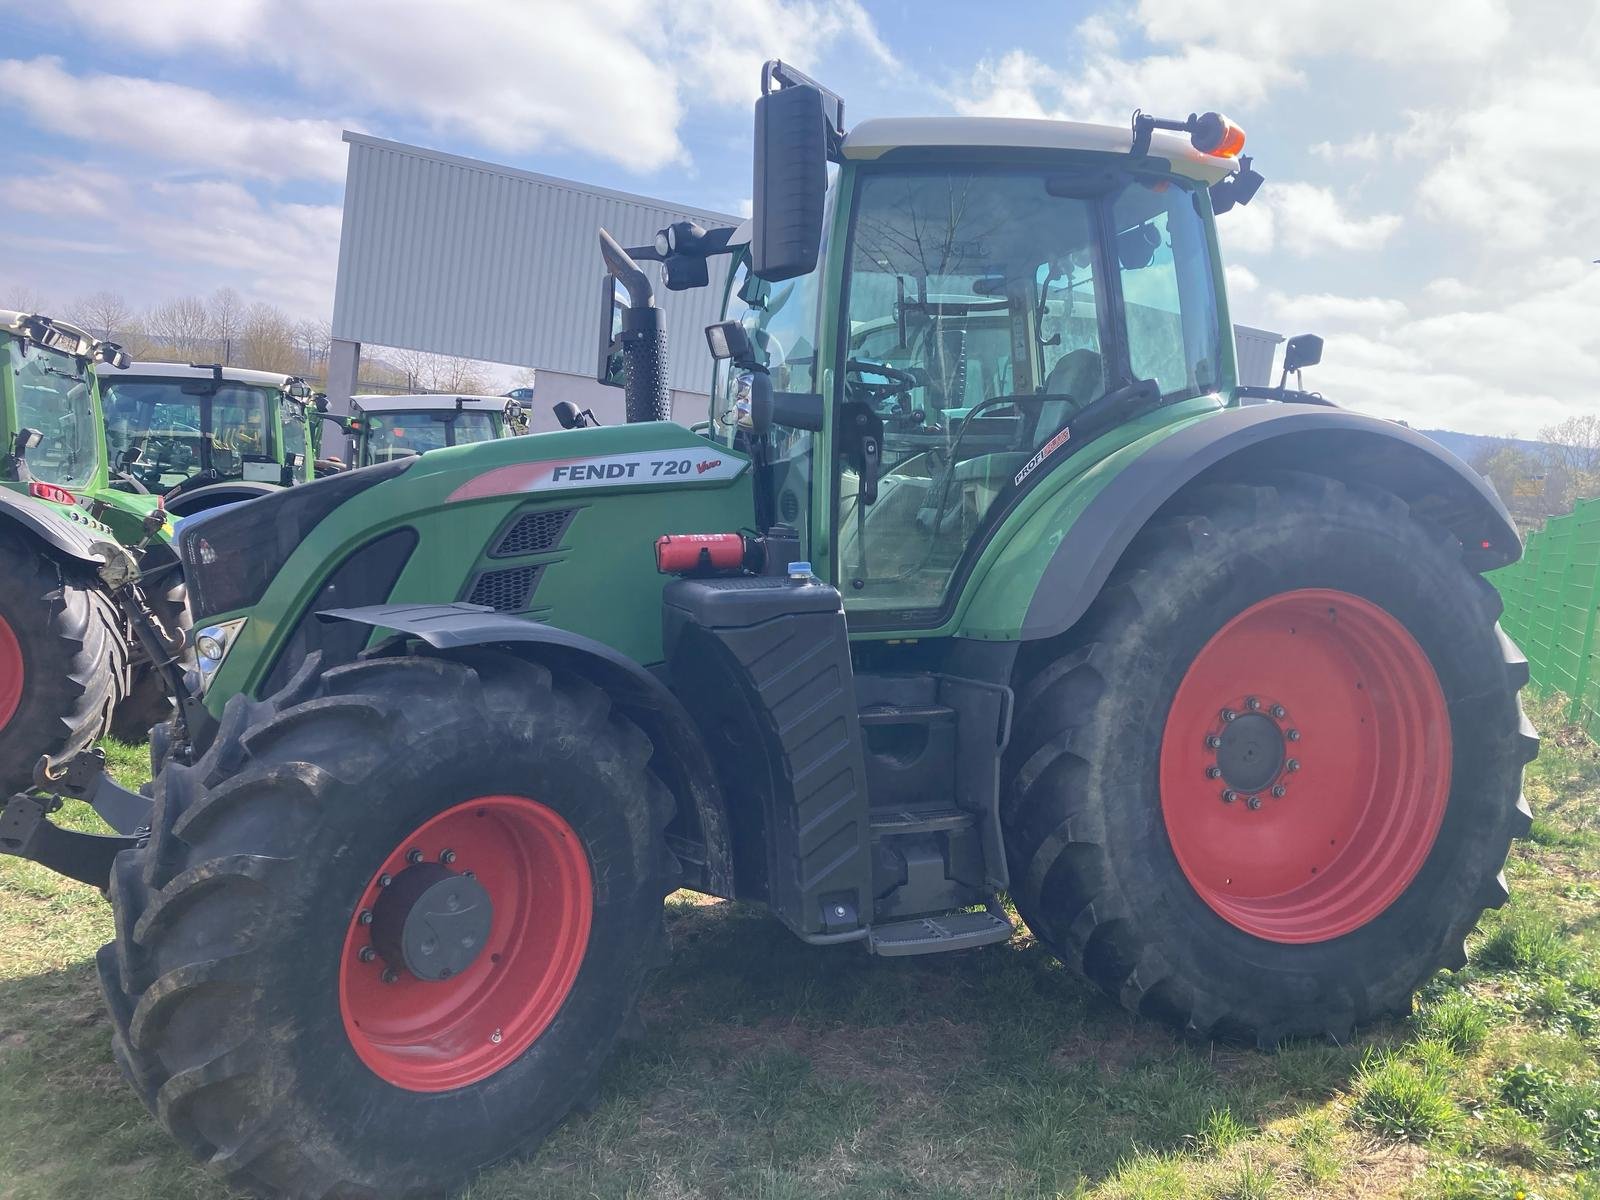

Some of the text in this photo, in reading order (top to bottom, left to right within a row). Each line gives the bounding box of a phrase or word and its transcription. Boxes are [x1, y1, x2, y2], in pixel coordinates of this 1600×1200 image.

[552, 462, 640, 482] FENDT
[650, 460, 692, 477] 720
[1016, 450, 1044, 484] PROFI
